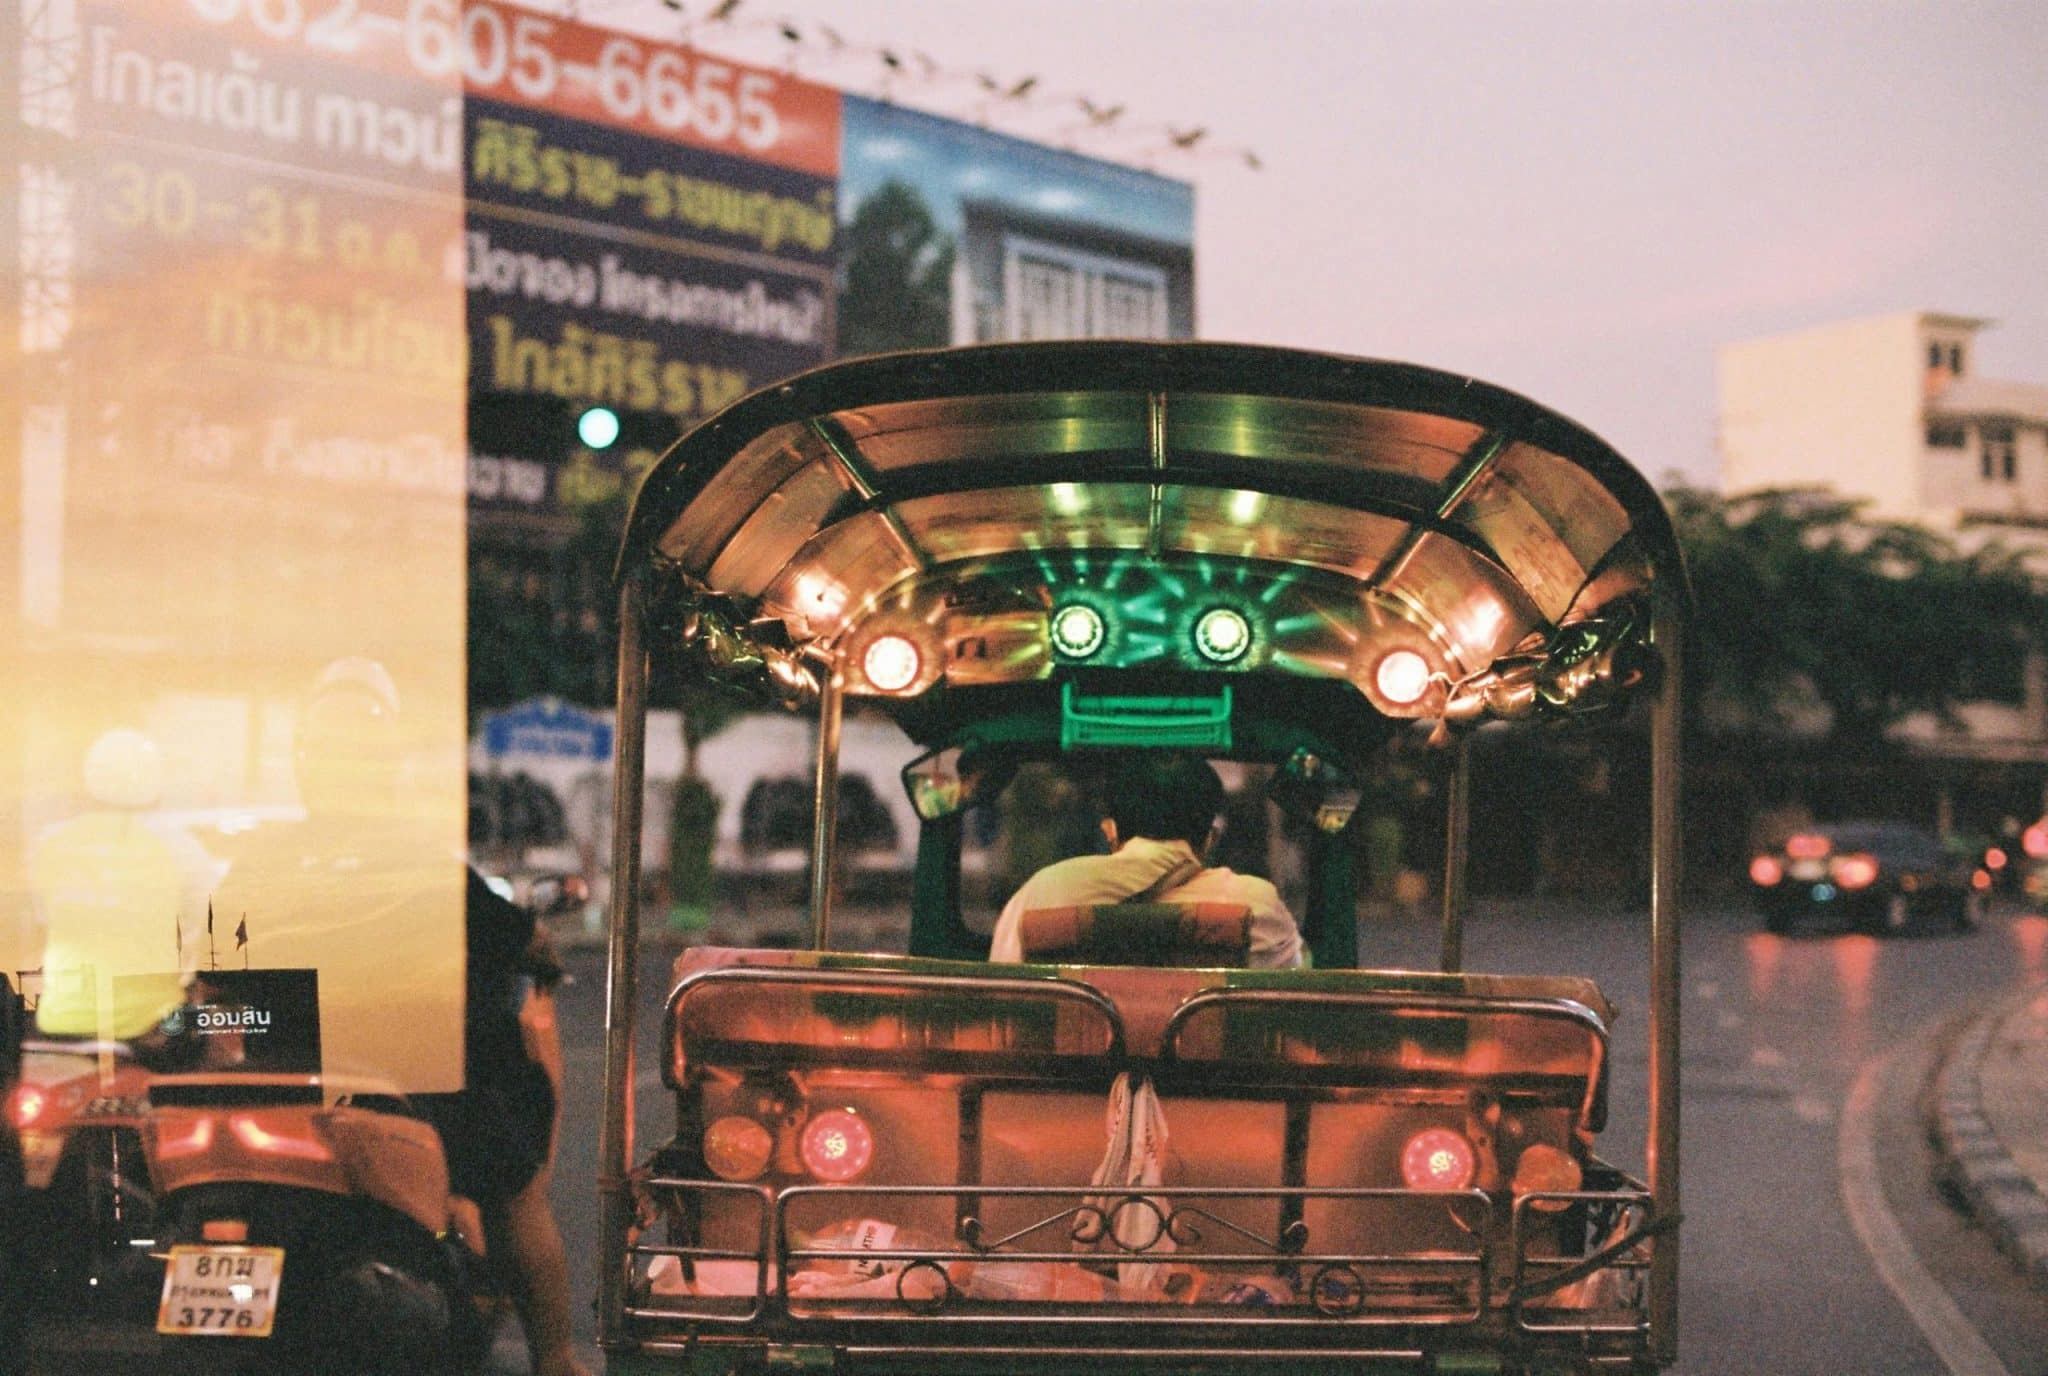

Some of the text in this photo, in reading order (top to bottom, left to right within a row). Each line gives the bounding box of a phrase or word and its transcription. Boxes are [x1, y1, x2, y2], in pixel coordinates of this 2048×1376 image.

[89, 26, 302, 142] โกลเด้น
[102, 160, 325, 264] 30-31
[197, 1006, 271, 1027] ออมสิน
[178, 1307, 254, 1330] 3776
